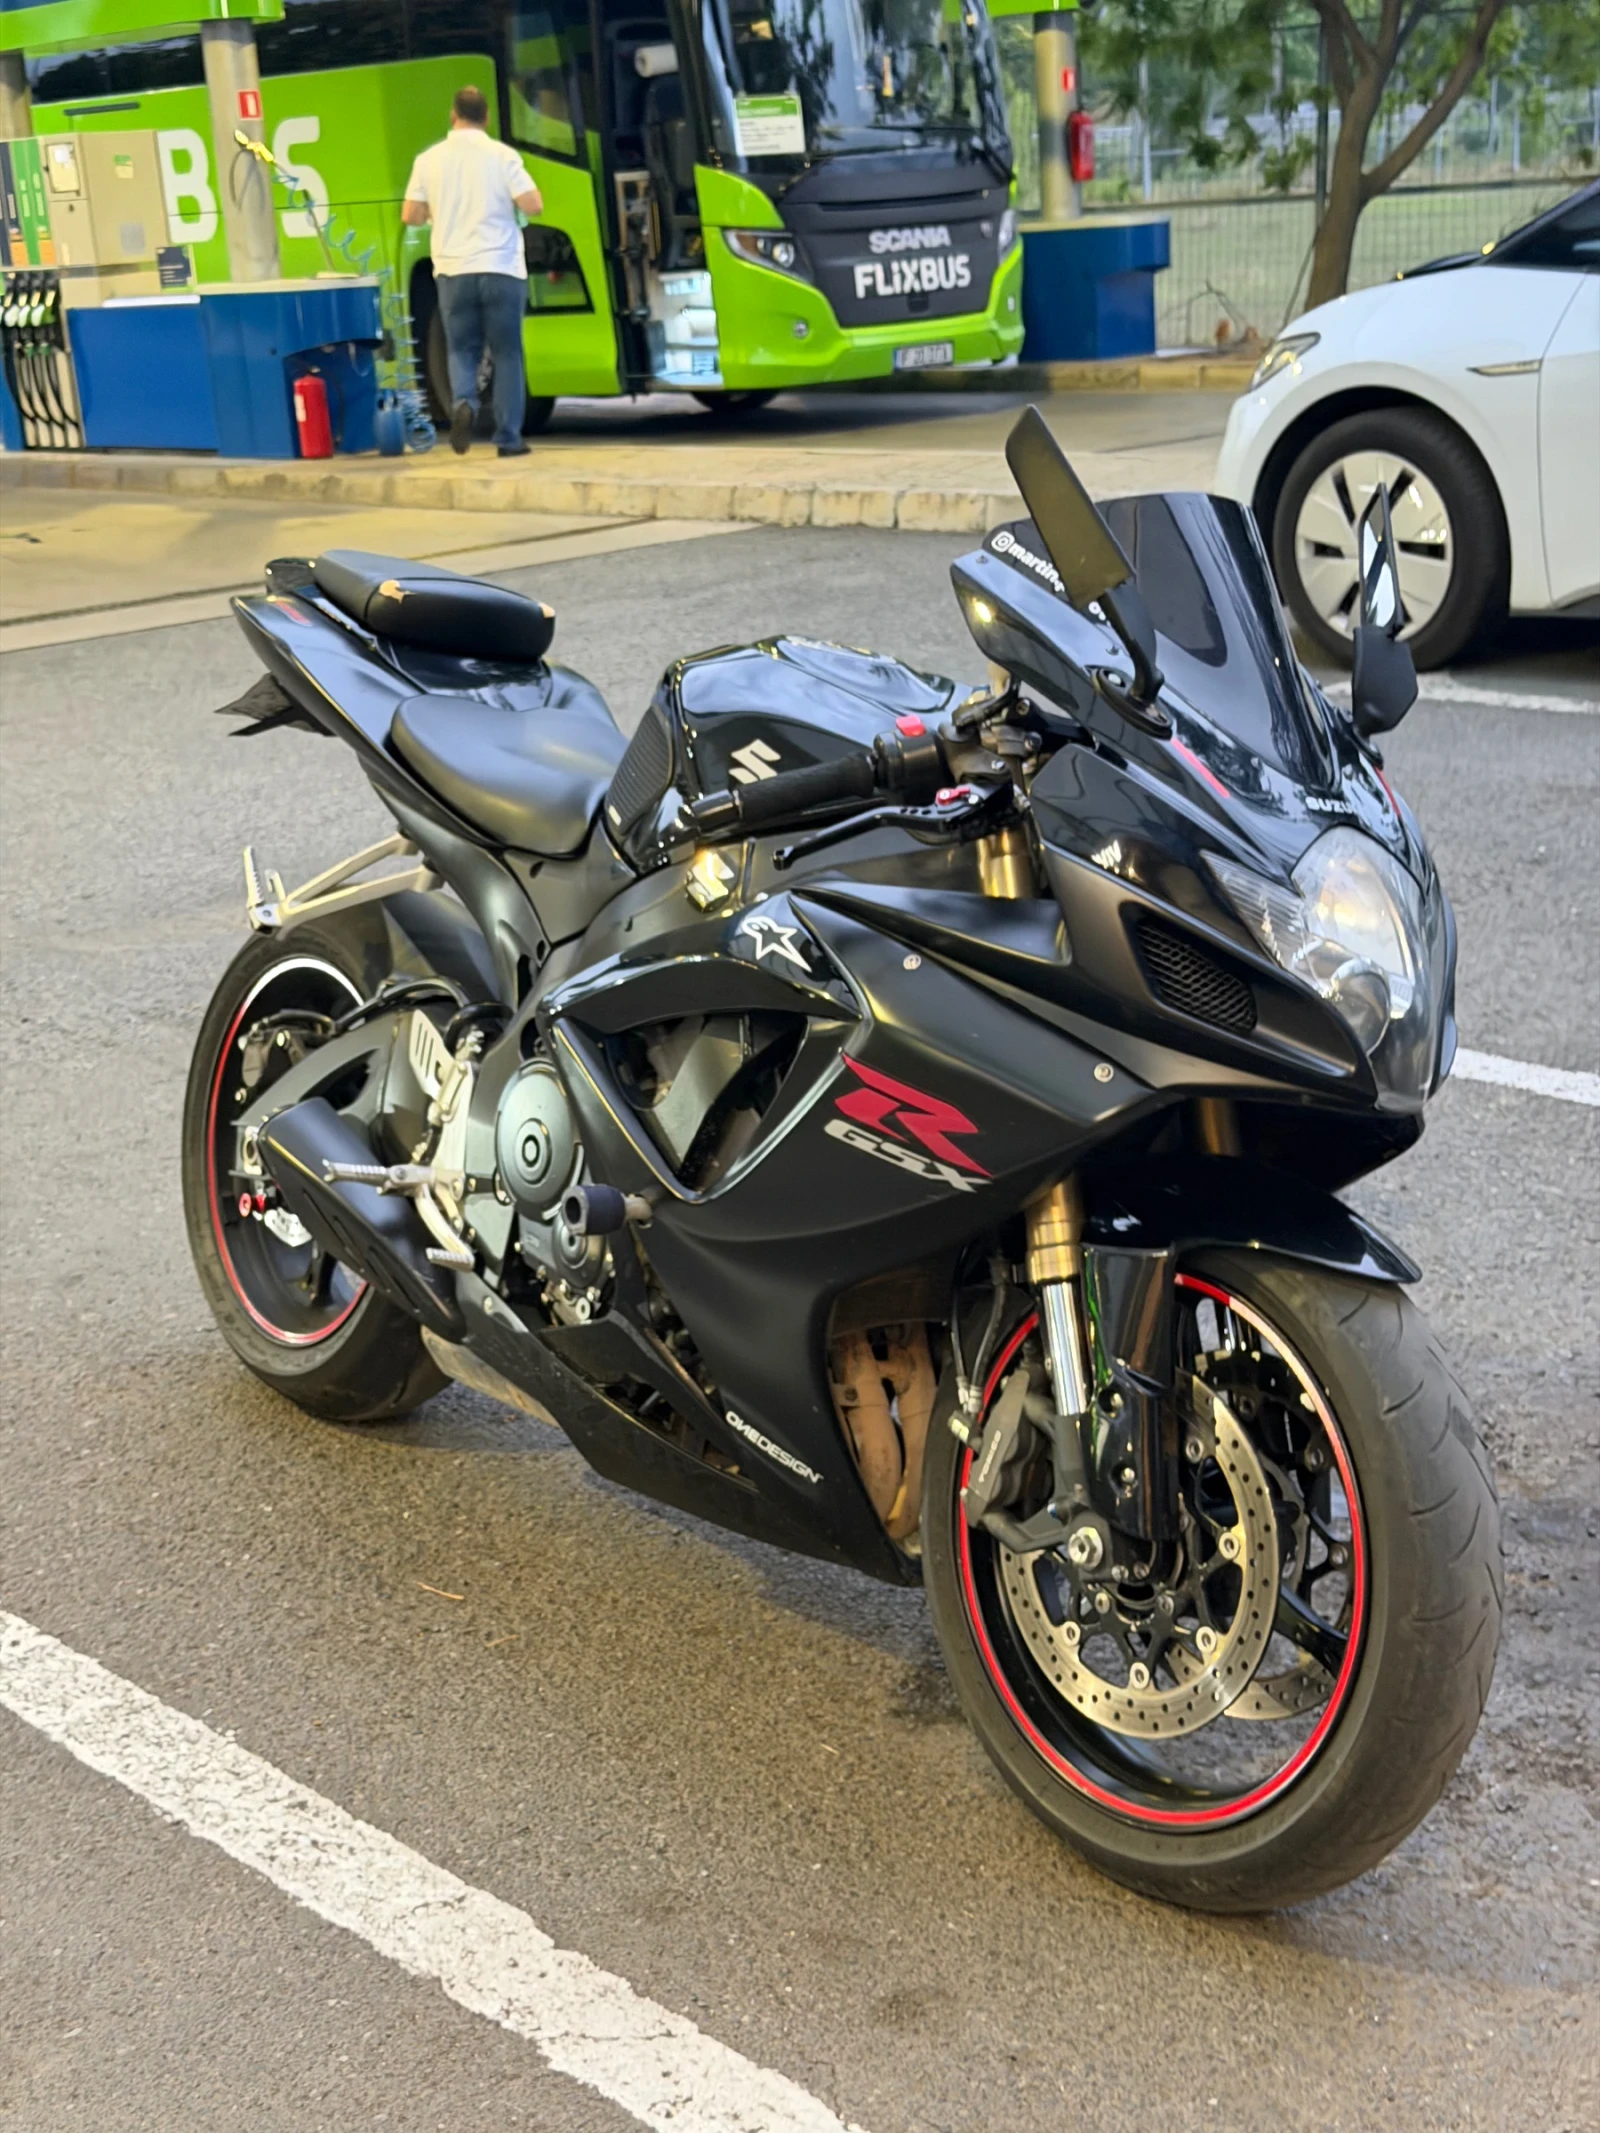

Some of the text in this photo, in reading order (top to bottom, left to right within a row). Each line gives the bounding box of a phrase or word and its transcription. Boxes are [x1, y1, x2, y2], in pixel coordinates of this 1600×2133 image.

[157, 116, 330, 244] BS
[868, 225, 952, 254] SCANIA
[823, 1118, 993, 1193] GSX
[725, 1410, 824, 1484] ONEDESIGN
